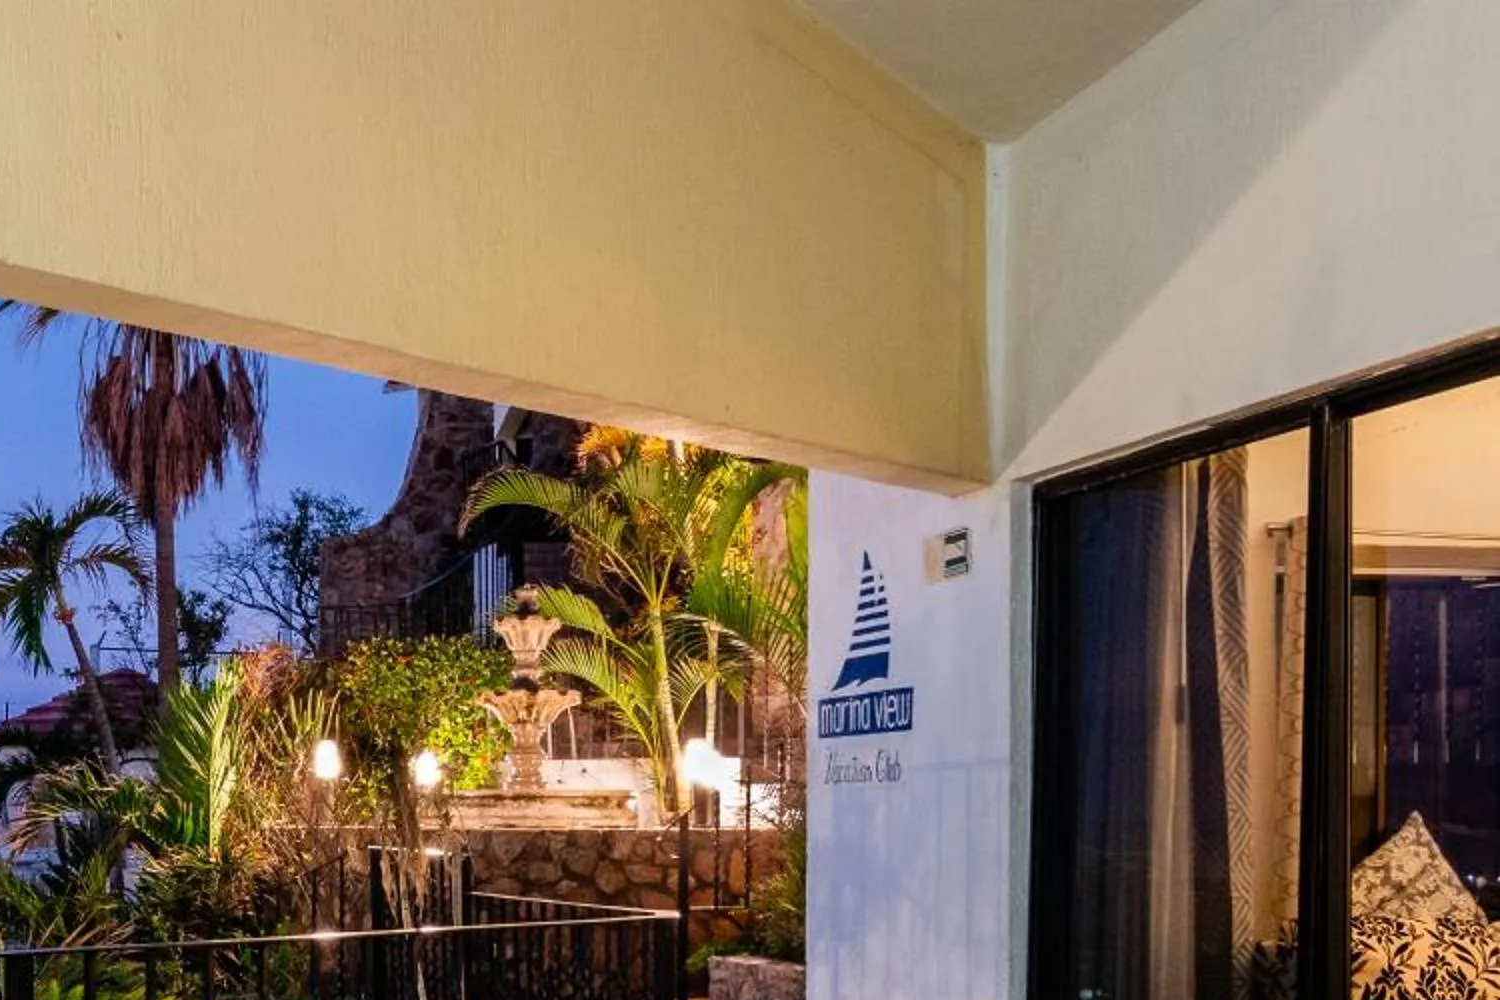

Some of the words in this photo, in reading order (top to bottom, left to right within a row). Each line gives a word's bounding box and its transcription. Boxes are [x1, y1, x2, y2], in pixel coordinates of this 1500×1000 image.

[821, 698, 870, 735] marina
[874, 692, 911, 729] view
[876, 749, 902, 783] Club
